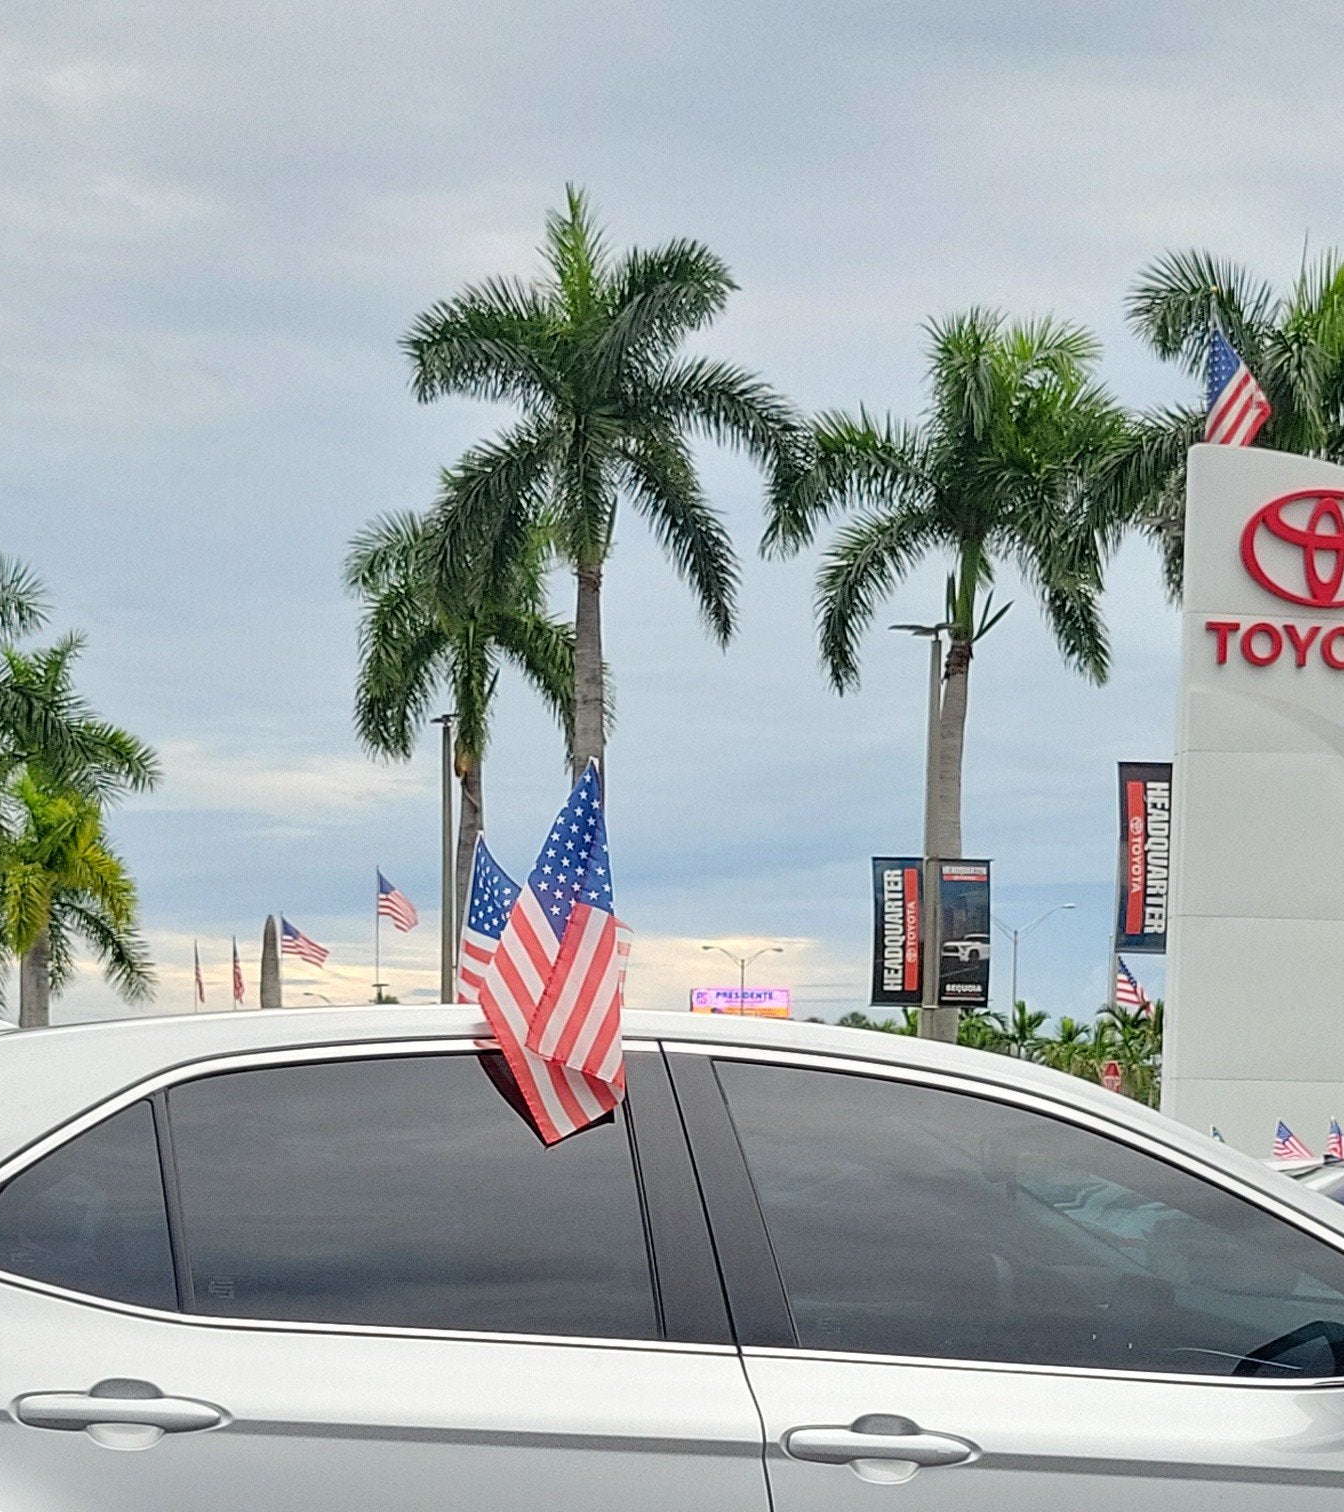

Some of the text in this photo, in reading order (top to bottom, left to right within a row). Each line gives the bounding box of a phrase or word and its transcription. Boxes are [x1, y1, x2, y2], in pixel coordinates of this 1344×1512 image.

[1131, 836, 1143, 894] TOYOTA
[1144, 782, 1170, 934] HEADQUARTER
[883, 869, 905, 991] HEADQUARTER
